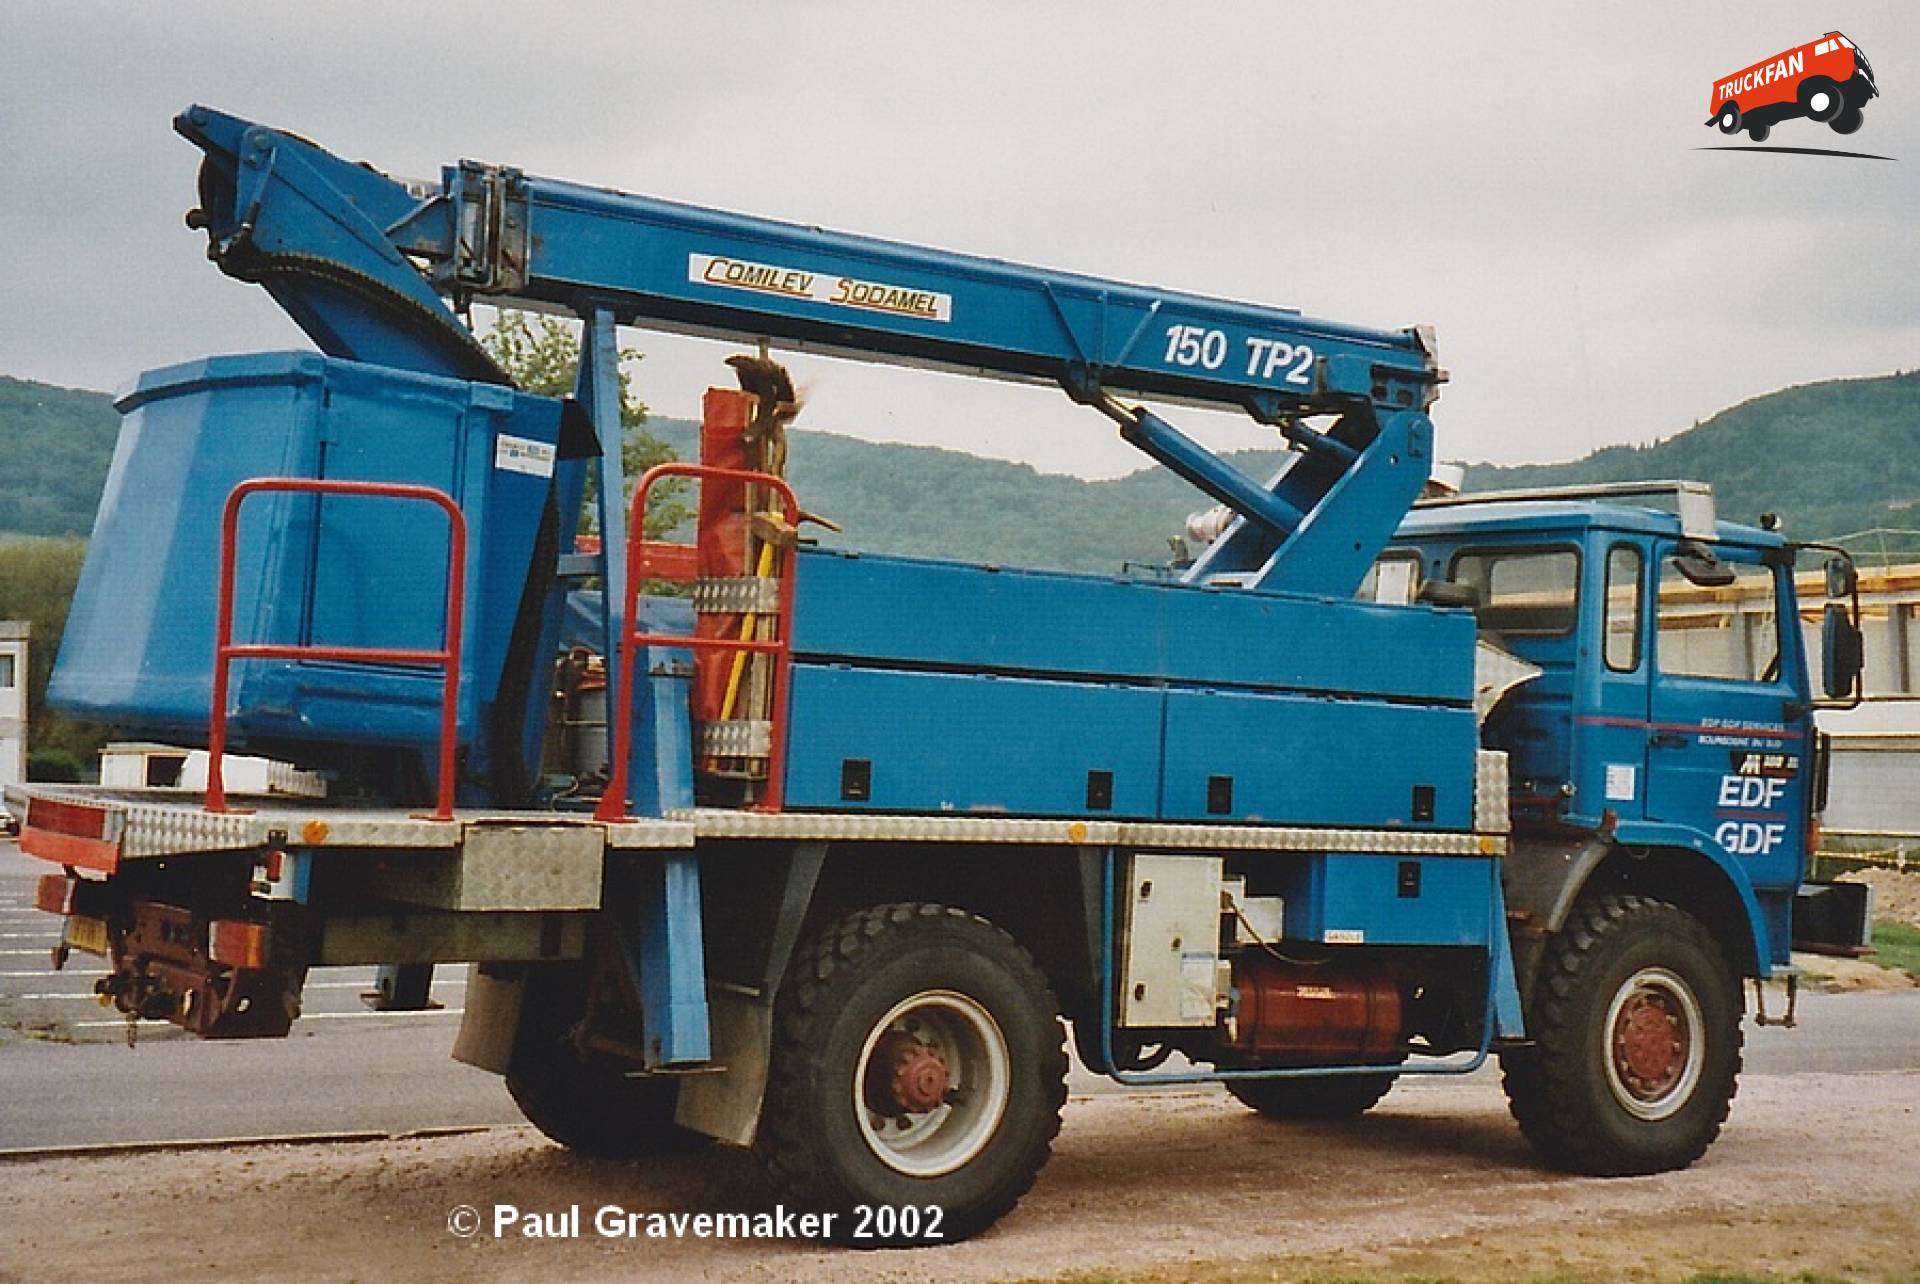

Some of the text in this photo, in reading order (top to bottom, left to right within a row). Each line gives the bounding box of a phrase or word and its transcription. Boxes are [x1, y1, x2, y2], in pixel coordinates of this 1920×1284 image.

[703, 256, 938, 316] COMILEV SODAMEL
[1165, 324, 1313, 385] 150 TP2
[1718, 775, 1787, 808] EDF
[1715, 821, 1787, 854] GDF
